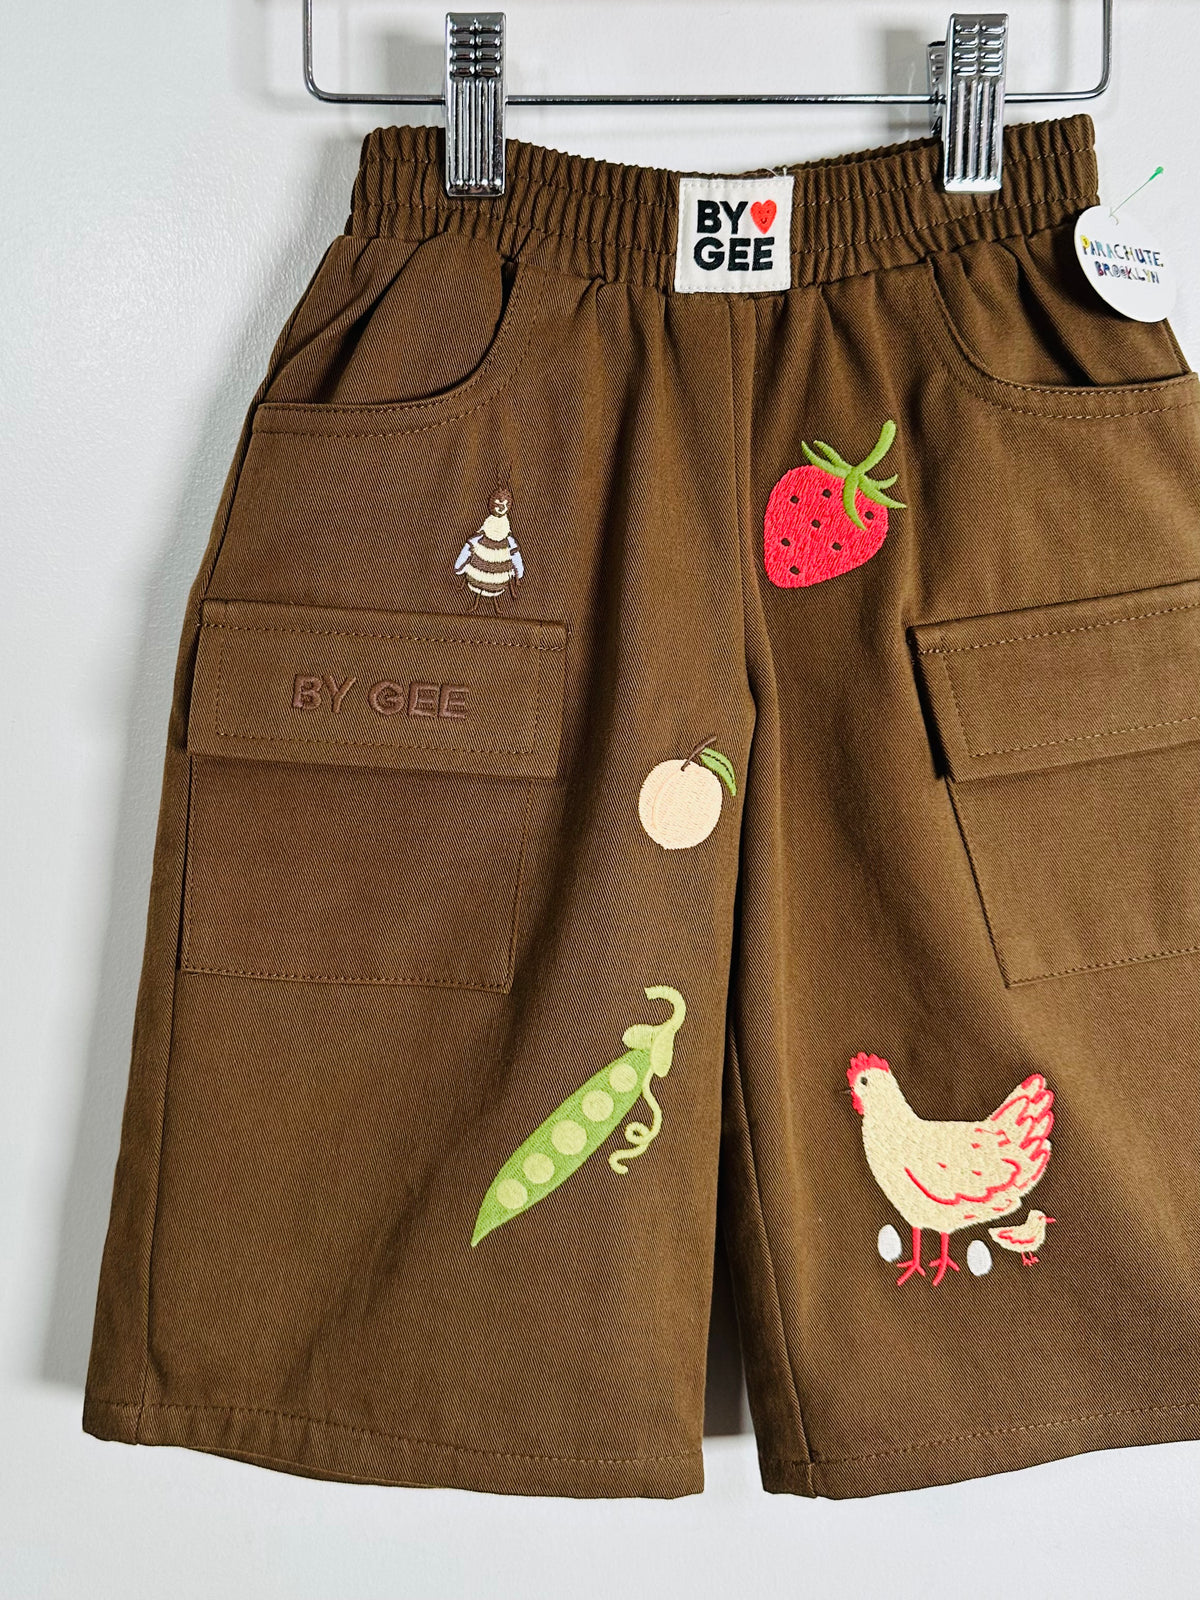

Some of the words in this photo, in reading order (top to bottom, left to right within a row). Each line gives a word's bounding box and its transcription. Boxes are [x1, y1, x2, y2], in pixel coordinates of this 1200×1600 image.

[696, 199, 749, 235] BY
[693, 236, 775, 271] GEE
[1094, 261, 1160, 284] BROOKLYN
[292, 674, 357, 714] BY
[367, 680, 471, 720] GEE
